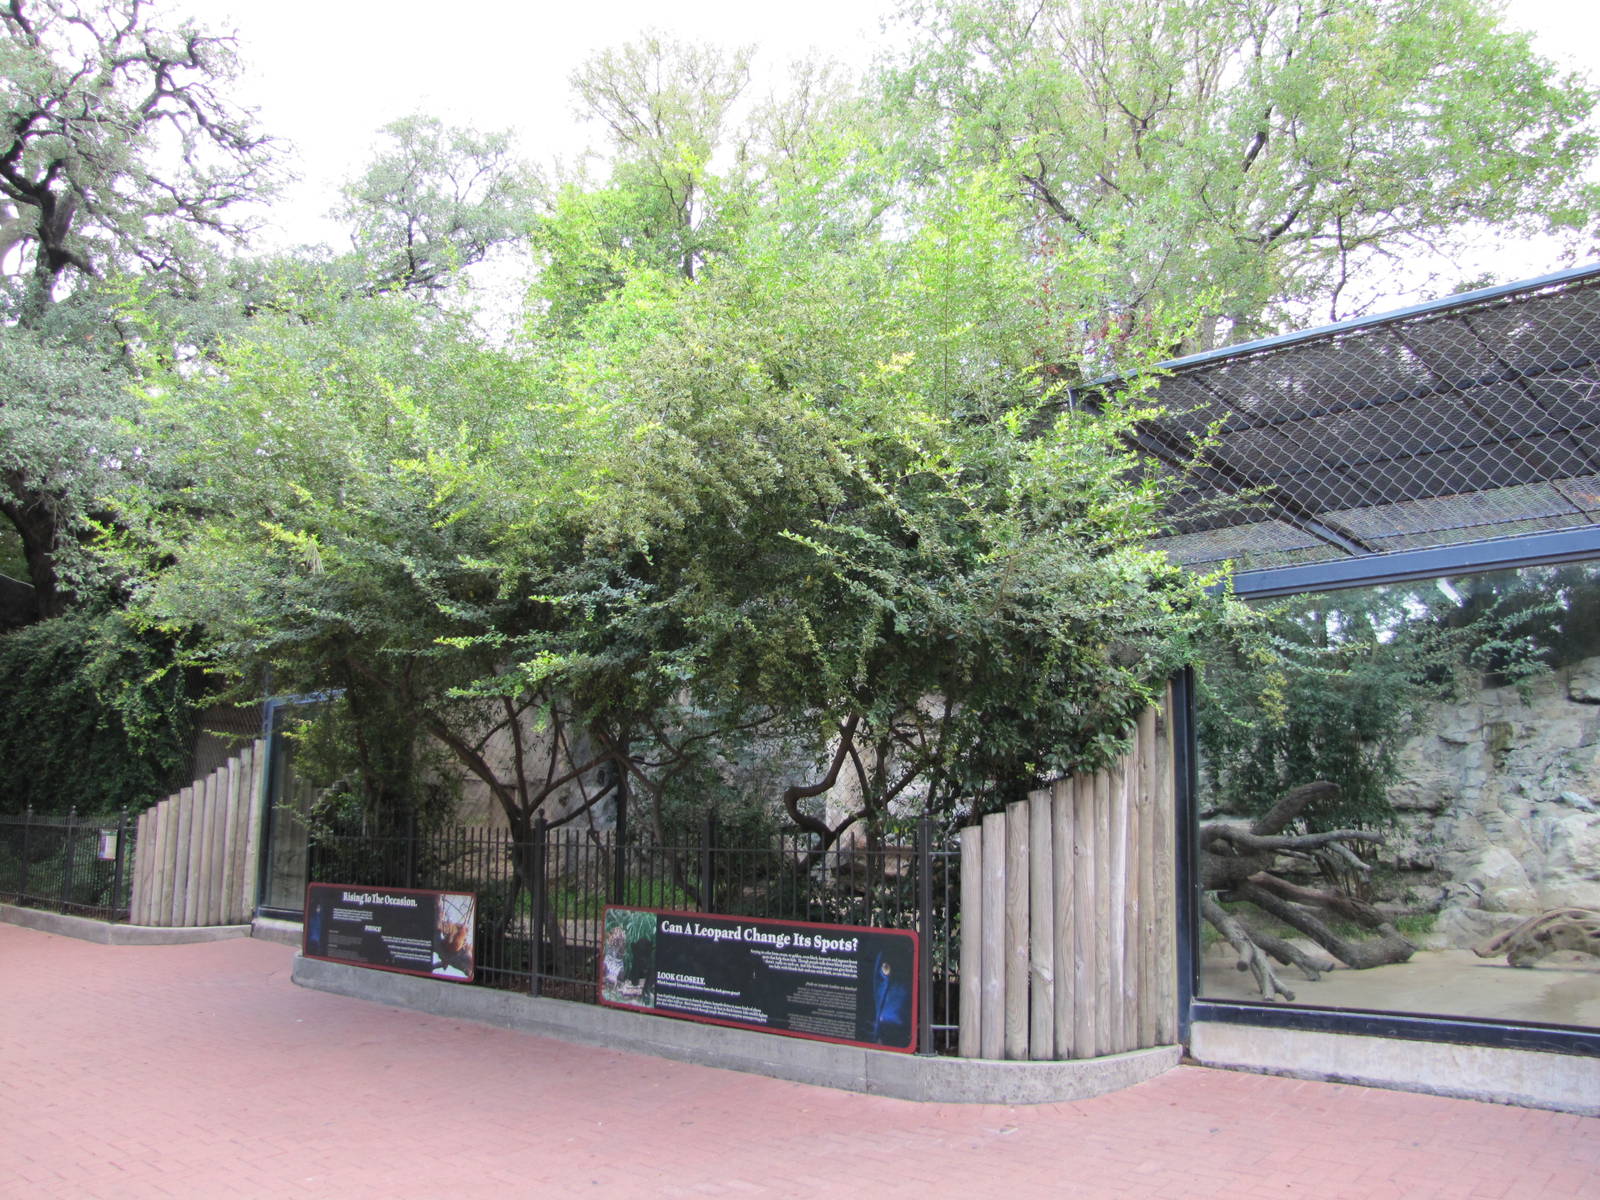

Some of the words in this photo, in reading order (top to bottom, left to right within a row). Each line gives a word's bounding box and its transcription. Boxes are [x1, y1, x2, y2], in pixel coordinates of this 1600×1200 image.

[343, 891, 364, 905] Rising
[364, 893, 371, 901] To
[372, 893, 384, 903] The
[385, 895, 418, 907] Occasion.
[661, 920, 683, 934] Can
[684, 923, 692, 935] A
[695, 924, 741, 942] Leopard
[743, 928, 791, 948] Change
[793, 933, 811, 947] Its
[813, 935, 859, 952] Spots?
[657, 971, 675, 981] LOOK
[676, 974, 706, 985] CLOSELY.
